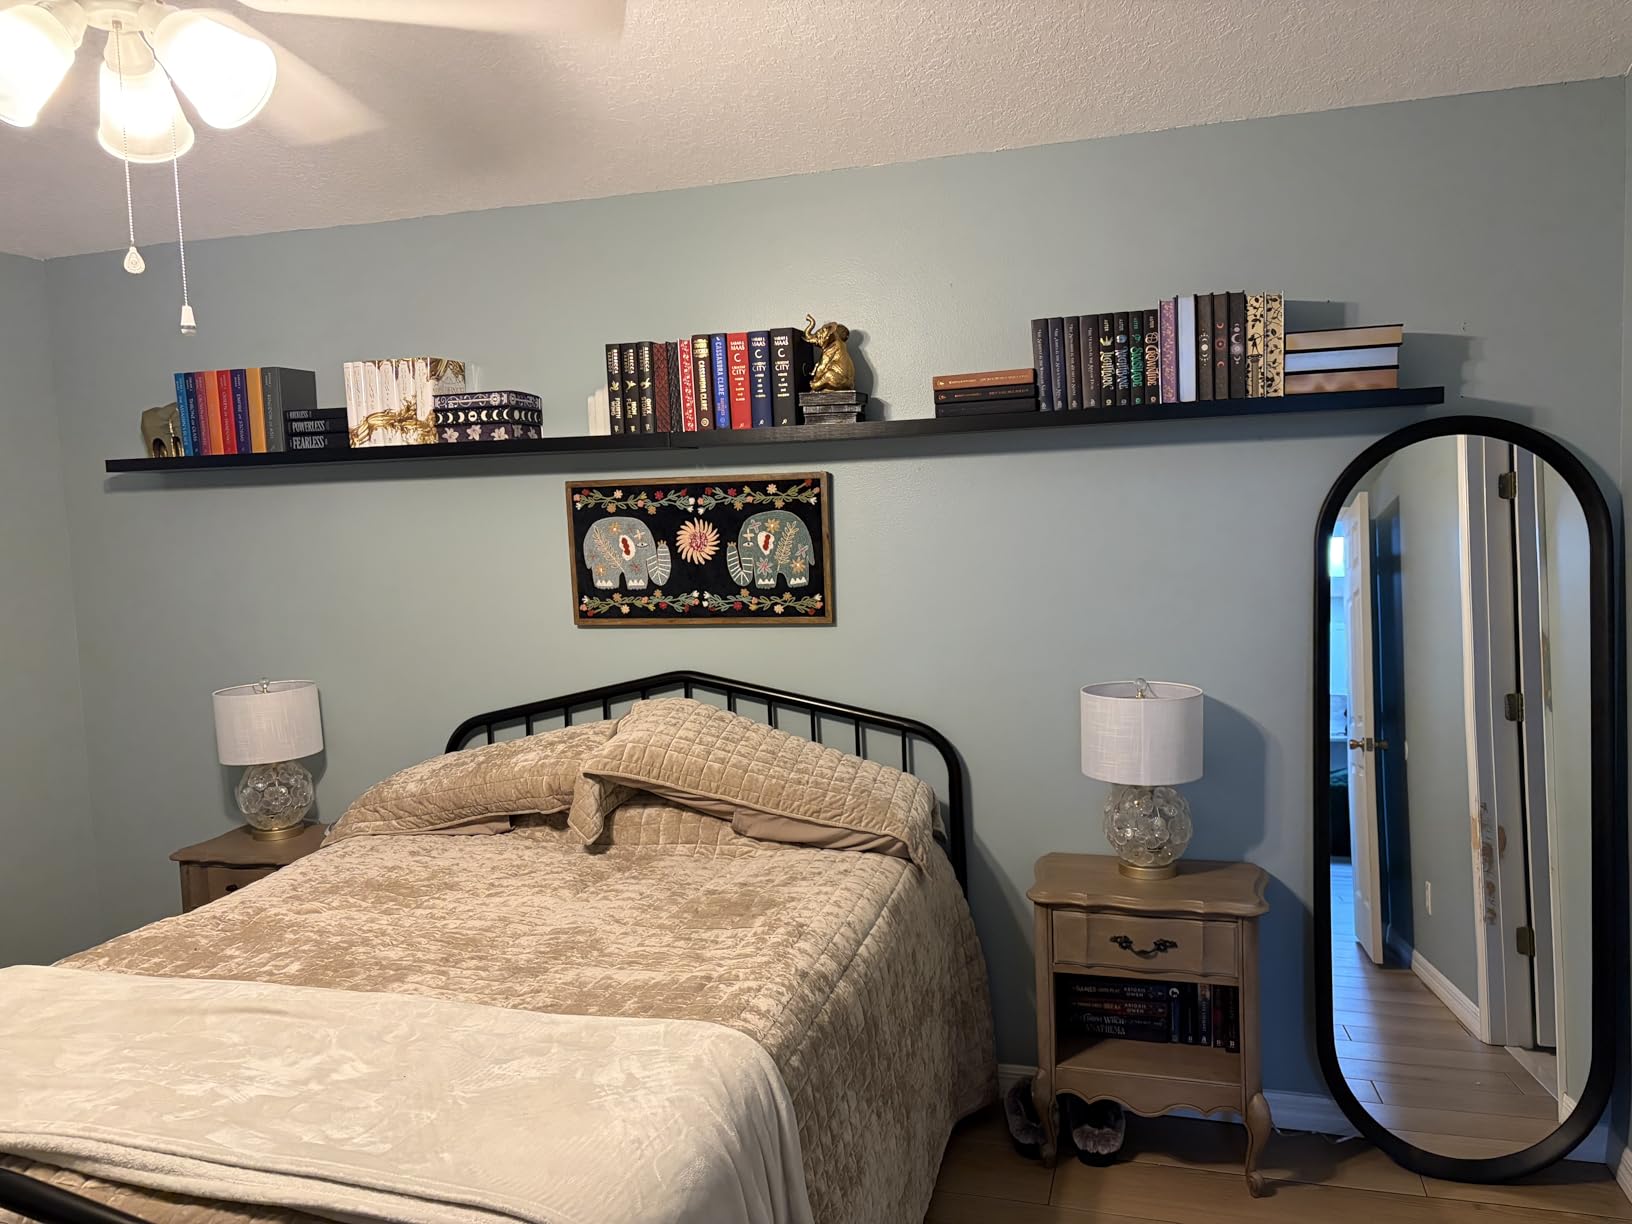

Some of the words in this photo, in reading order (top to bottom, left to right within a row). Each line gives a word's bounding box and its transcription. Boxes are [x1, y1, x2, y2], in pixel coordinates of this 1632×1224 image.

[715, 341, 723, 376] CASSANDRA
[700, 393, 708, 411] CLARE
[292, 420, 325, 432] POWERLESS
[293, 436, 325, 449] FEARLESS
